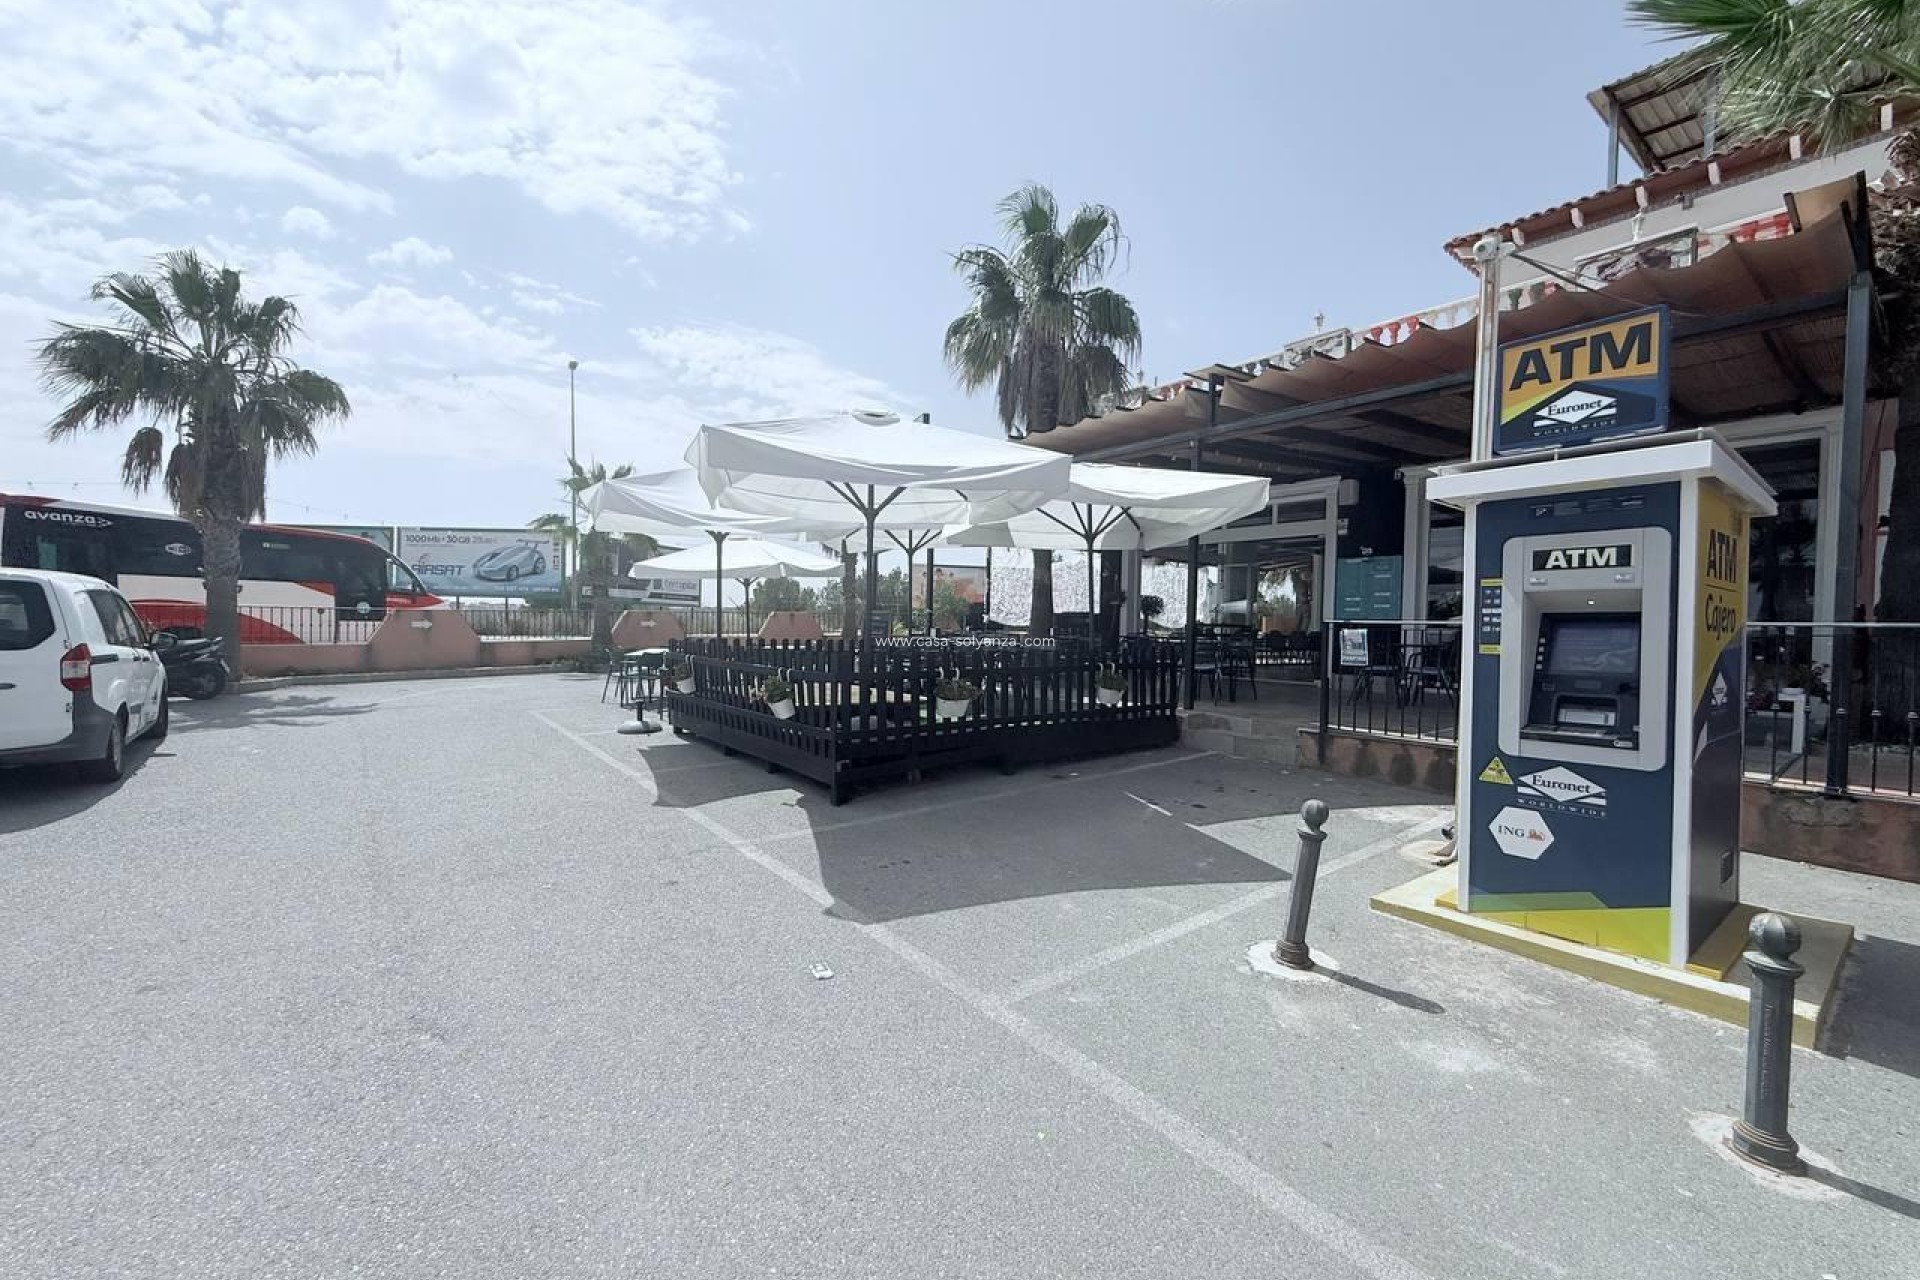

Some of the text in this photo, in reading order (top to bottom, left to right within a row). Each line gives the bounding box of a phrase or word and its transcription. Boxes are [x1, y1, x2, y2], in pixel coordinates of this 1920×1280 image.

[1508, 322, 1652, 391] ATM
[1547, 399, 1602, 416] Euronet
[1533, 419, 1617, 437] WORLDWIDE
[23, 509, 96, 525] avanza
[1544, 546, 1618, 569] ATM
[1706, 528, 1738, 584] ATM
[1705, 593, 1736, 641] Cajero
[1532, 774, 1591, 794] Euronet
[1517, 798, 1606, 818] WORLDWIDE
[1497, 824, 1525, 839] ING
